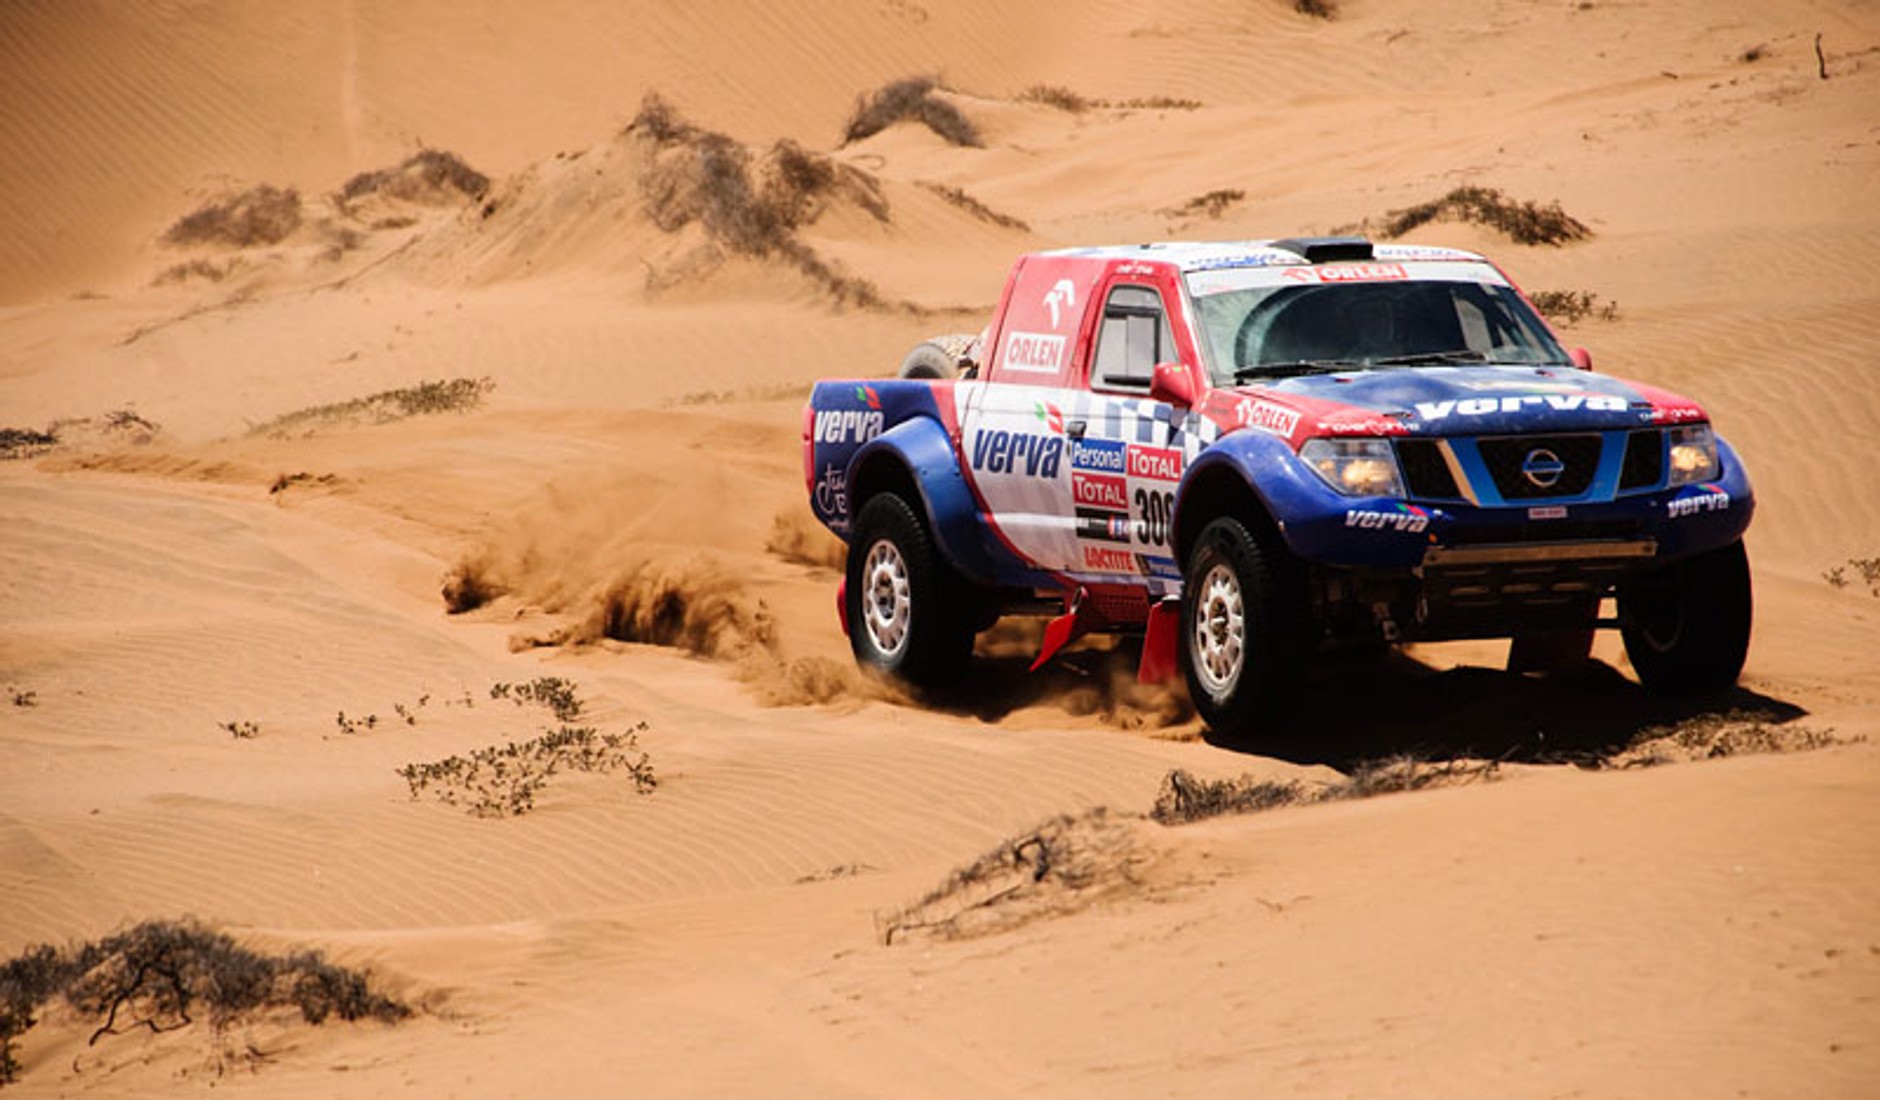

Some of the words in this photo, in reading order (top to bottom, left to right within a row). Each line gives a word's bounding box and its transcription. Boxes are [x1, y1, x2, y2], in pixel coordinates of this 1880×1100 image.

[1320, 262, 1402, 281] ORLEN
[1008, 337, 1060, 367] ORLEN
[1252, 405, 1297, 433] ORLEN
[1415, 395, 1629, 421] verva
[815, 410, 885, 443] verva
[973, 429, 1064, 479] verva
[1073, 441, 1126, 470] Personal
[1666, 493, 1730, 519] verva
[1345, 509, 1430, 533] verva
[1084, 545, 1136, 573] LOCTITE
